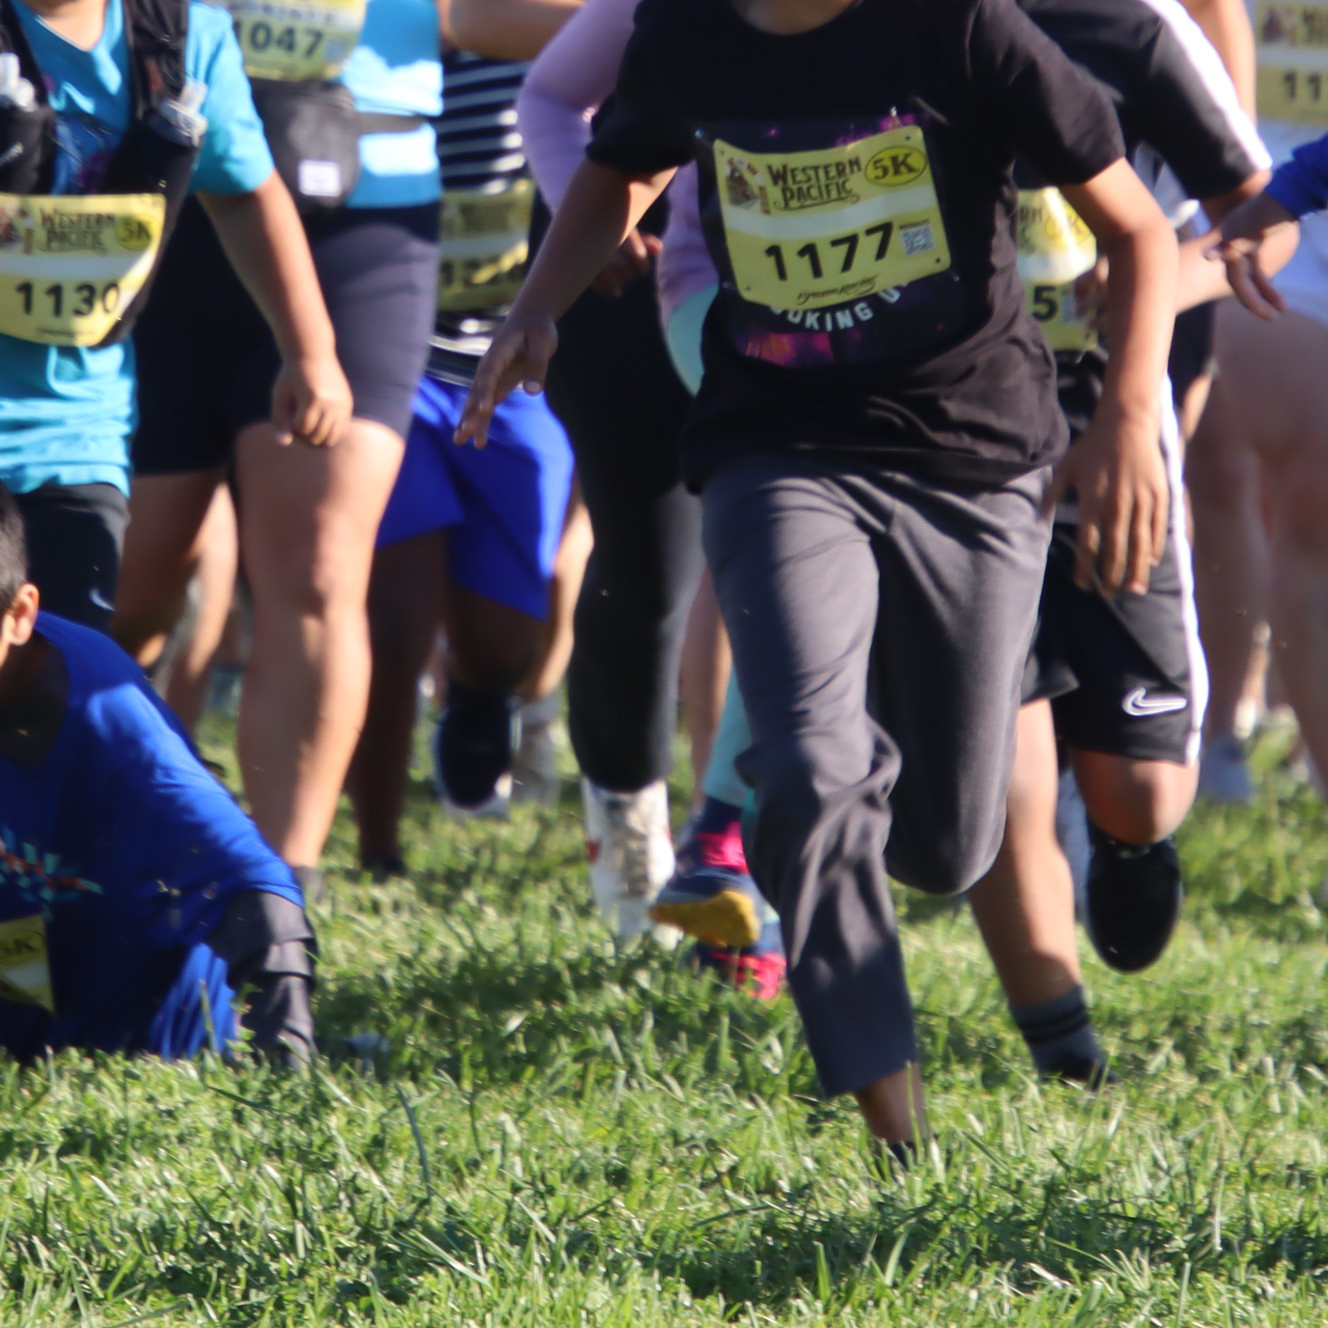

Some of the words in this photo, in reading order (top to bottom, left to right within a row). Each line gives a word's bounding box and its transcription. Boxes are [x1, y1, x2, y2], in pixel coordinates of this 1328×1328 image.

[767, 157, 862, 188] WESTERN
[871, 151, 917, 181] 5K
[781, 178, 854, 208] PACIFIC
[764, 221, 894, 282] 1177
[15, 282, 121, 318] 1130
